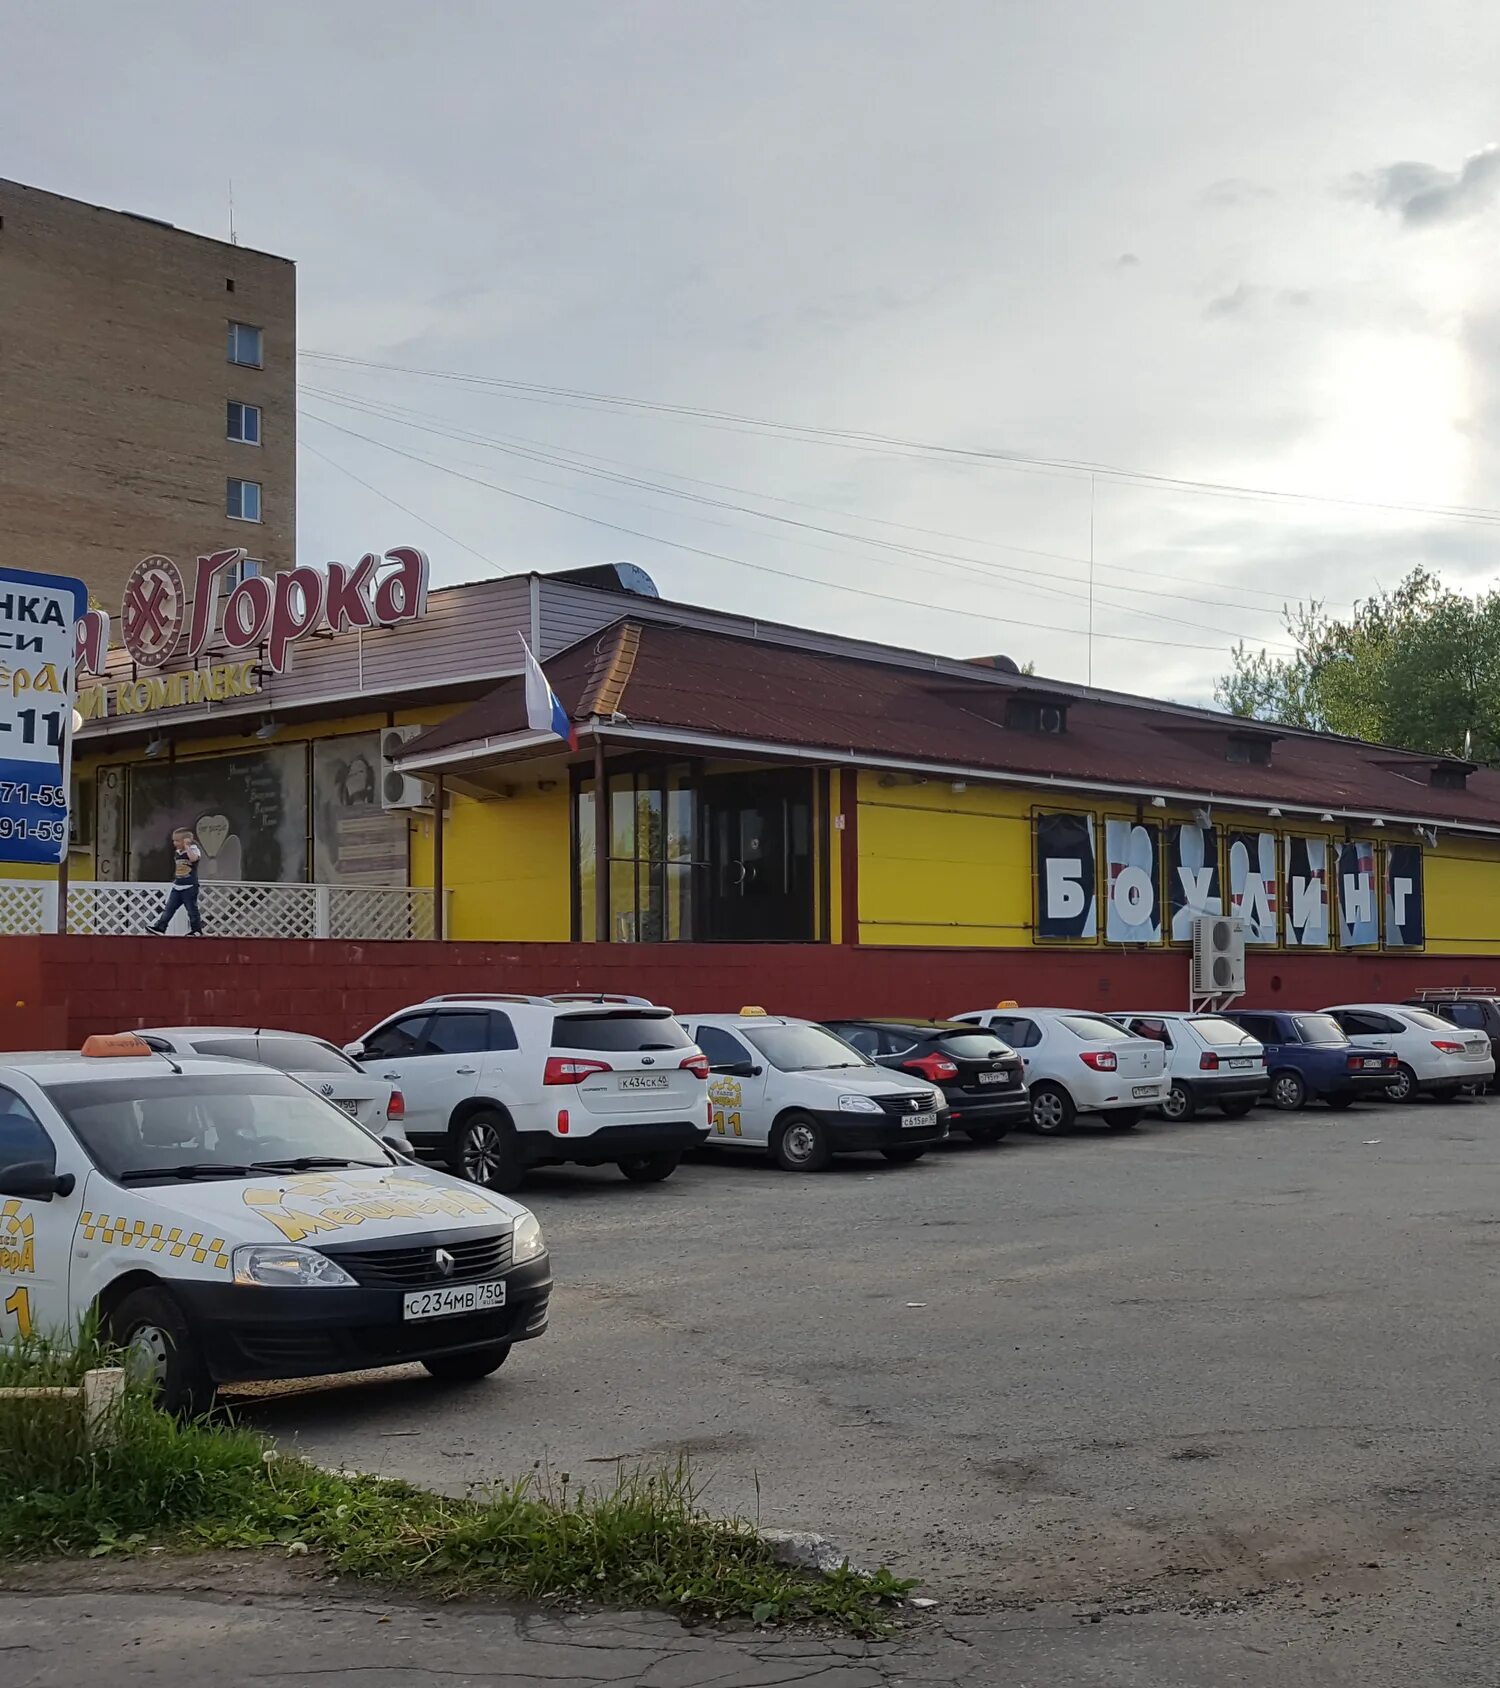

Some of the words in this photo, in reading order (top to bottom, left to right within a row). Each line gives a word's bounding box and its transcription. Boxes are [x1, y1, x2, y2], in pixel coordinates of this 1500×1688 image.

[188, 546, 428, 676] Горка
[116, 658, 257, 715] КОМПЛЕКС
[1046, 857, 1413, 929] БОУЛИНГ
[622, 1077, 658, 1088] К434СК
[713, 1110, 743, 1136] 11
[410, 1291, 474, 1315] С234МВ
[478, 1283, 502, 1301] 750
